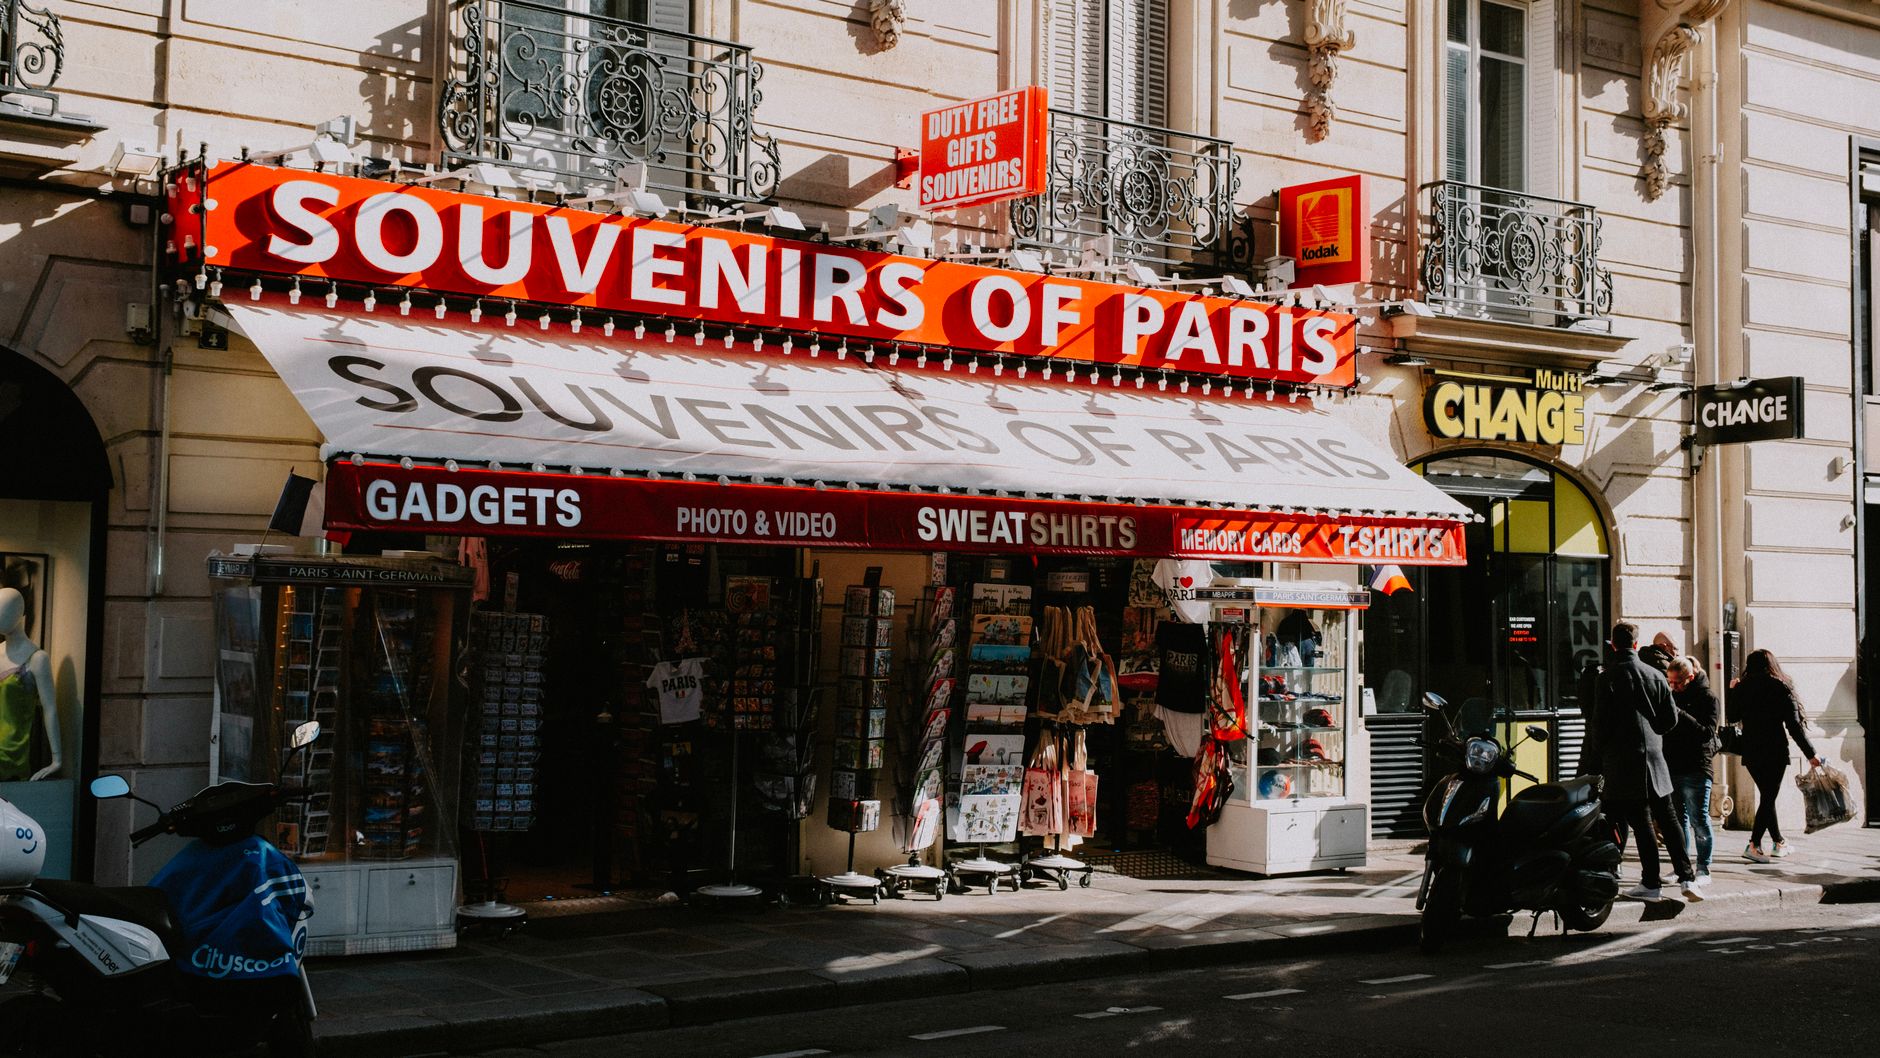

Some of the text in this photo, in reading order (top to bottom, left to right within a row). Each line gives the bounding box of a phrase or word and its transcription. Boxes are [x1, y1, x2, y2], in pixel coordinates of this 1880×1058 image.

[928, 93, 1019, 141] DUTY FREE
[947, 130, 996, 163] GIFTS
[922, 156, 1022, 204] SOUVENIRS
[1302, 244, 1339, 261] Kodak
[268, 180, 1338, 376] SOUVENIRS OF PARIS
[208, 333, 218, 346] 4
[1535, 369, 1582, 392] Multi
[328, 355, 1391, 481] SOUVENIRS OF PARIS
[1433, 381, 1584, 446] CHANGE
[1702, 396, 1788, 428] CHANGE
[366, 479, 582, 528] GADGETS
[677, 506, 837, 538] PHOTO & VIDEO
[1181, 527, 1301, 554] MEMORY CARDS
[1338, 525, 1444, 558] T-SHIRTS
[289, 566, 444, 583] PARIS SAINT-GERMAIN
[1173, 576, 1179, 589] I
[1273, 592, 1355, 602] PARIS SAINT-GERMAIN
[1167, 652, 1197, 666] PARIS
[662, 675, 697, 694] PARIS
[97, 949, 120, 973] Uber
